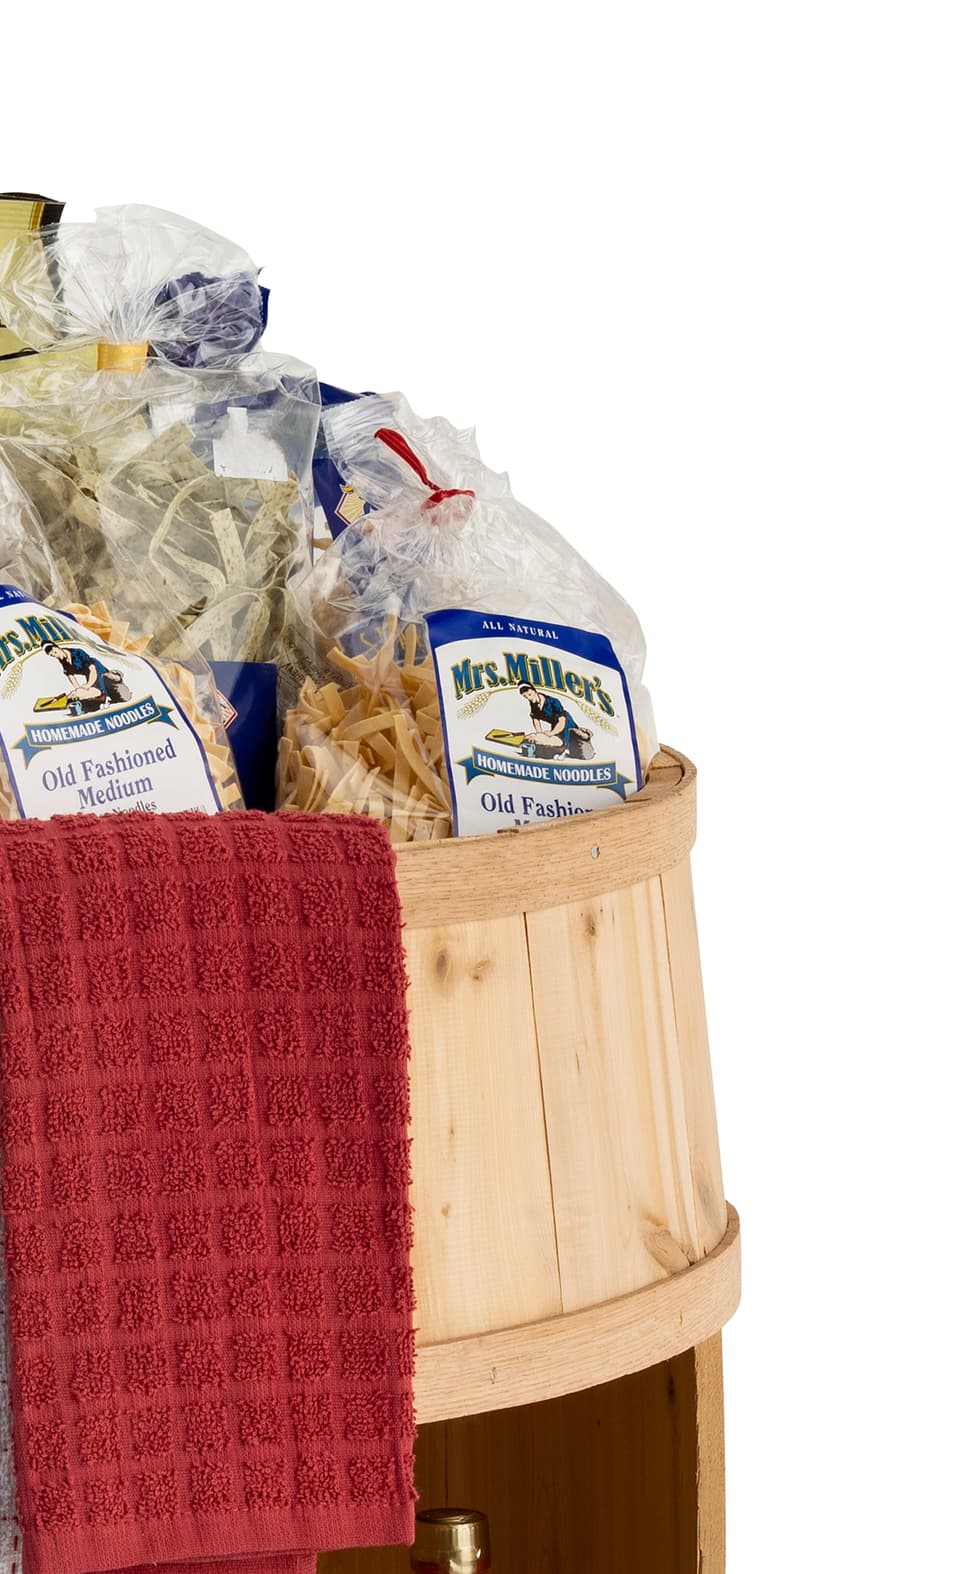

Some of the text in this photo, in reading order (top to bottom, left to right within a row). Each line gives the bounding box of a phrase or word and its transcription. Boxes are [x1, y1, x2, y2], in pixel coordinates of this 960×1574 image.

[482, 620, 560, 640] ALL NATURAL
[30, 701, 156, 744] HOMEMADE NOODLES
[41, 737, 178, 792] Old Fashioned
[476, 753, 612, 783] HOMEMADE NOODLES
[76, 773, 155, 810] Medium
[480, 792, 593, 818] Old Fashi
